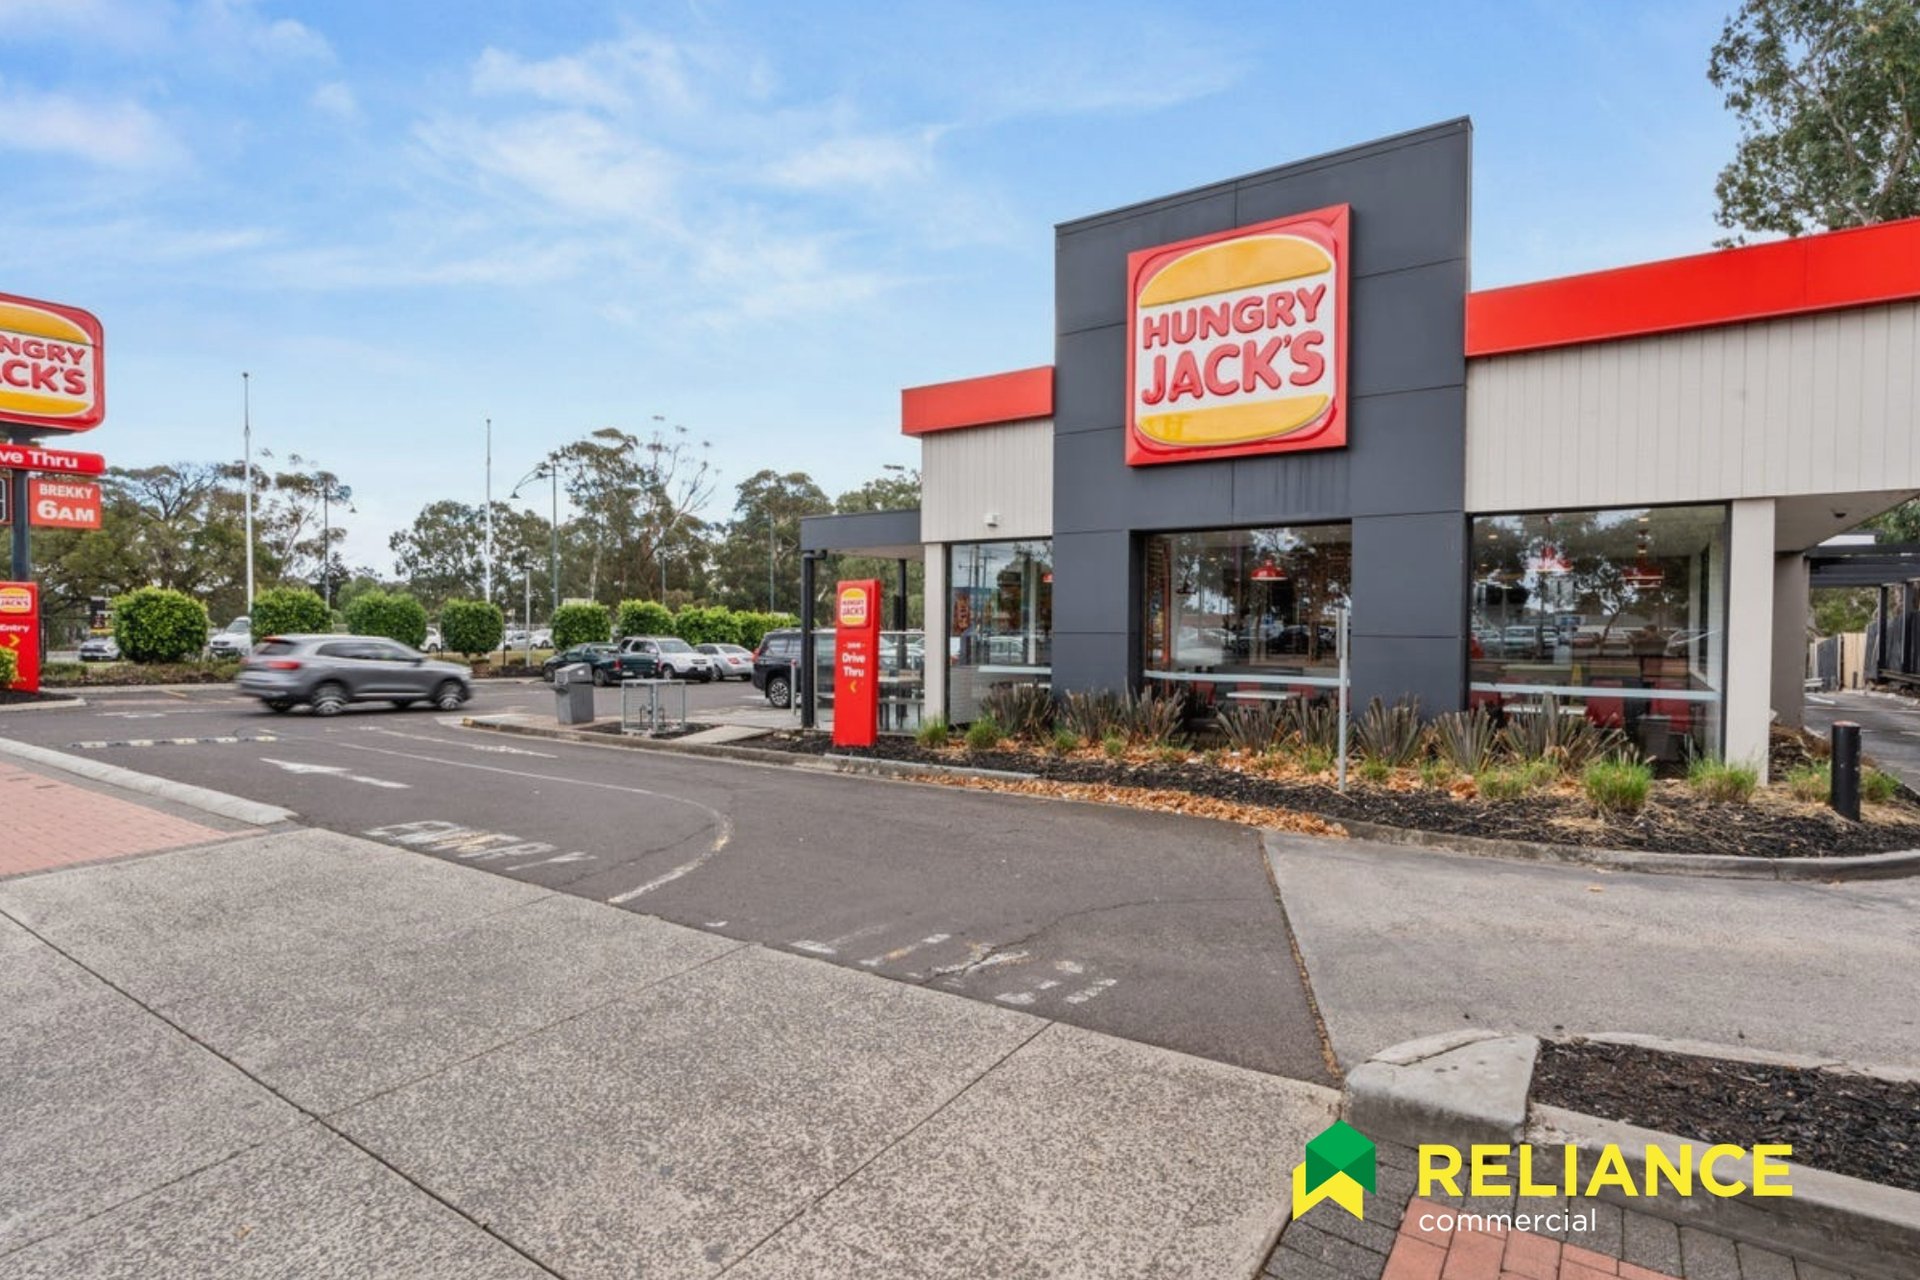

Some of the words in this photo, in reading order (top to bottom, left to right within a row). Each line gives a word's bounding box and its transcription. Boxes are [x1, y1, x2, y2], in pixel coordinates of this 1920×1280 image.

[1143, 283, 1326, 350] HUNGRY
[0, 359, 87, 395] CK'S
[1141, 330, 1325, 405] JACK'S
[27, 450, 78, 468] Thru
[38, 483, 94, 500] BREKKY
[37, 499, 96, 522] 6AM
[842, 652, 866, 664] Drive
[843, 666, 865, 678] Thru
